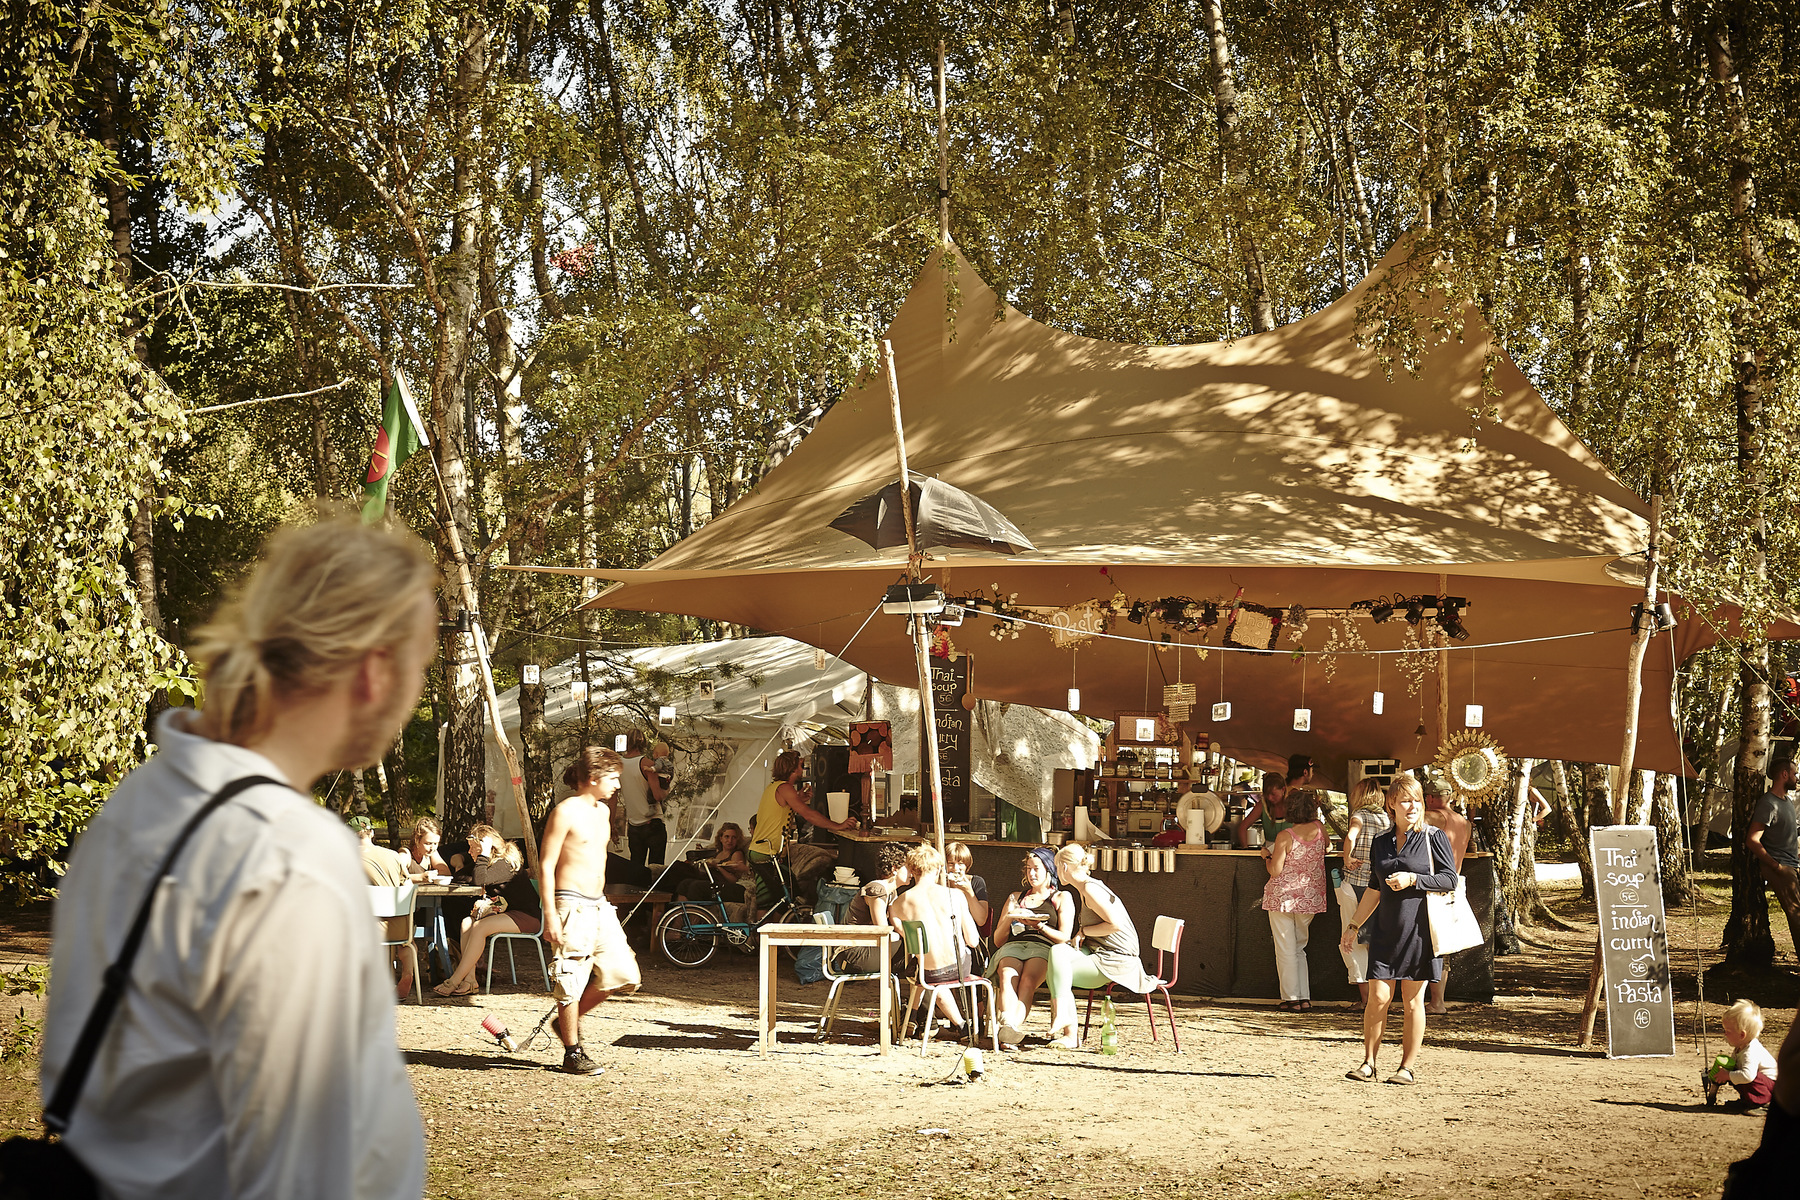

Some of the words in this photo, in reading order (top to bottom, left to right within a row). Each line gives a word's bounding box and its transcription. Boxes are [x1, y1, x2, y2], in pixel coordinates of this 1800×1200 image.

[1052, 606, 1104, 641] Pasta
[932, 682, 957, 695] soup
[936, 713, 965, 731] ndian
[1599, 847, 1638, 868] Thai
[1621, 891, 1637, 901] 5€
[1611, 909, 1659, 933] indian
[1610, 937, 1656, 962] curry
[1613, 982, 1662, 1003] Pasta
[1635, 1011, 1649, 1025] 4€
